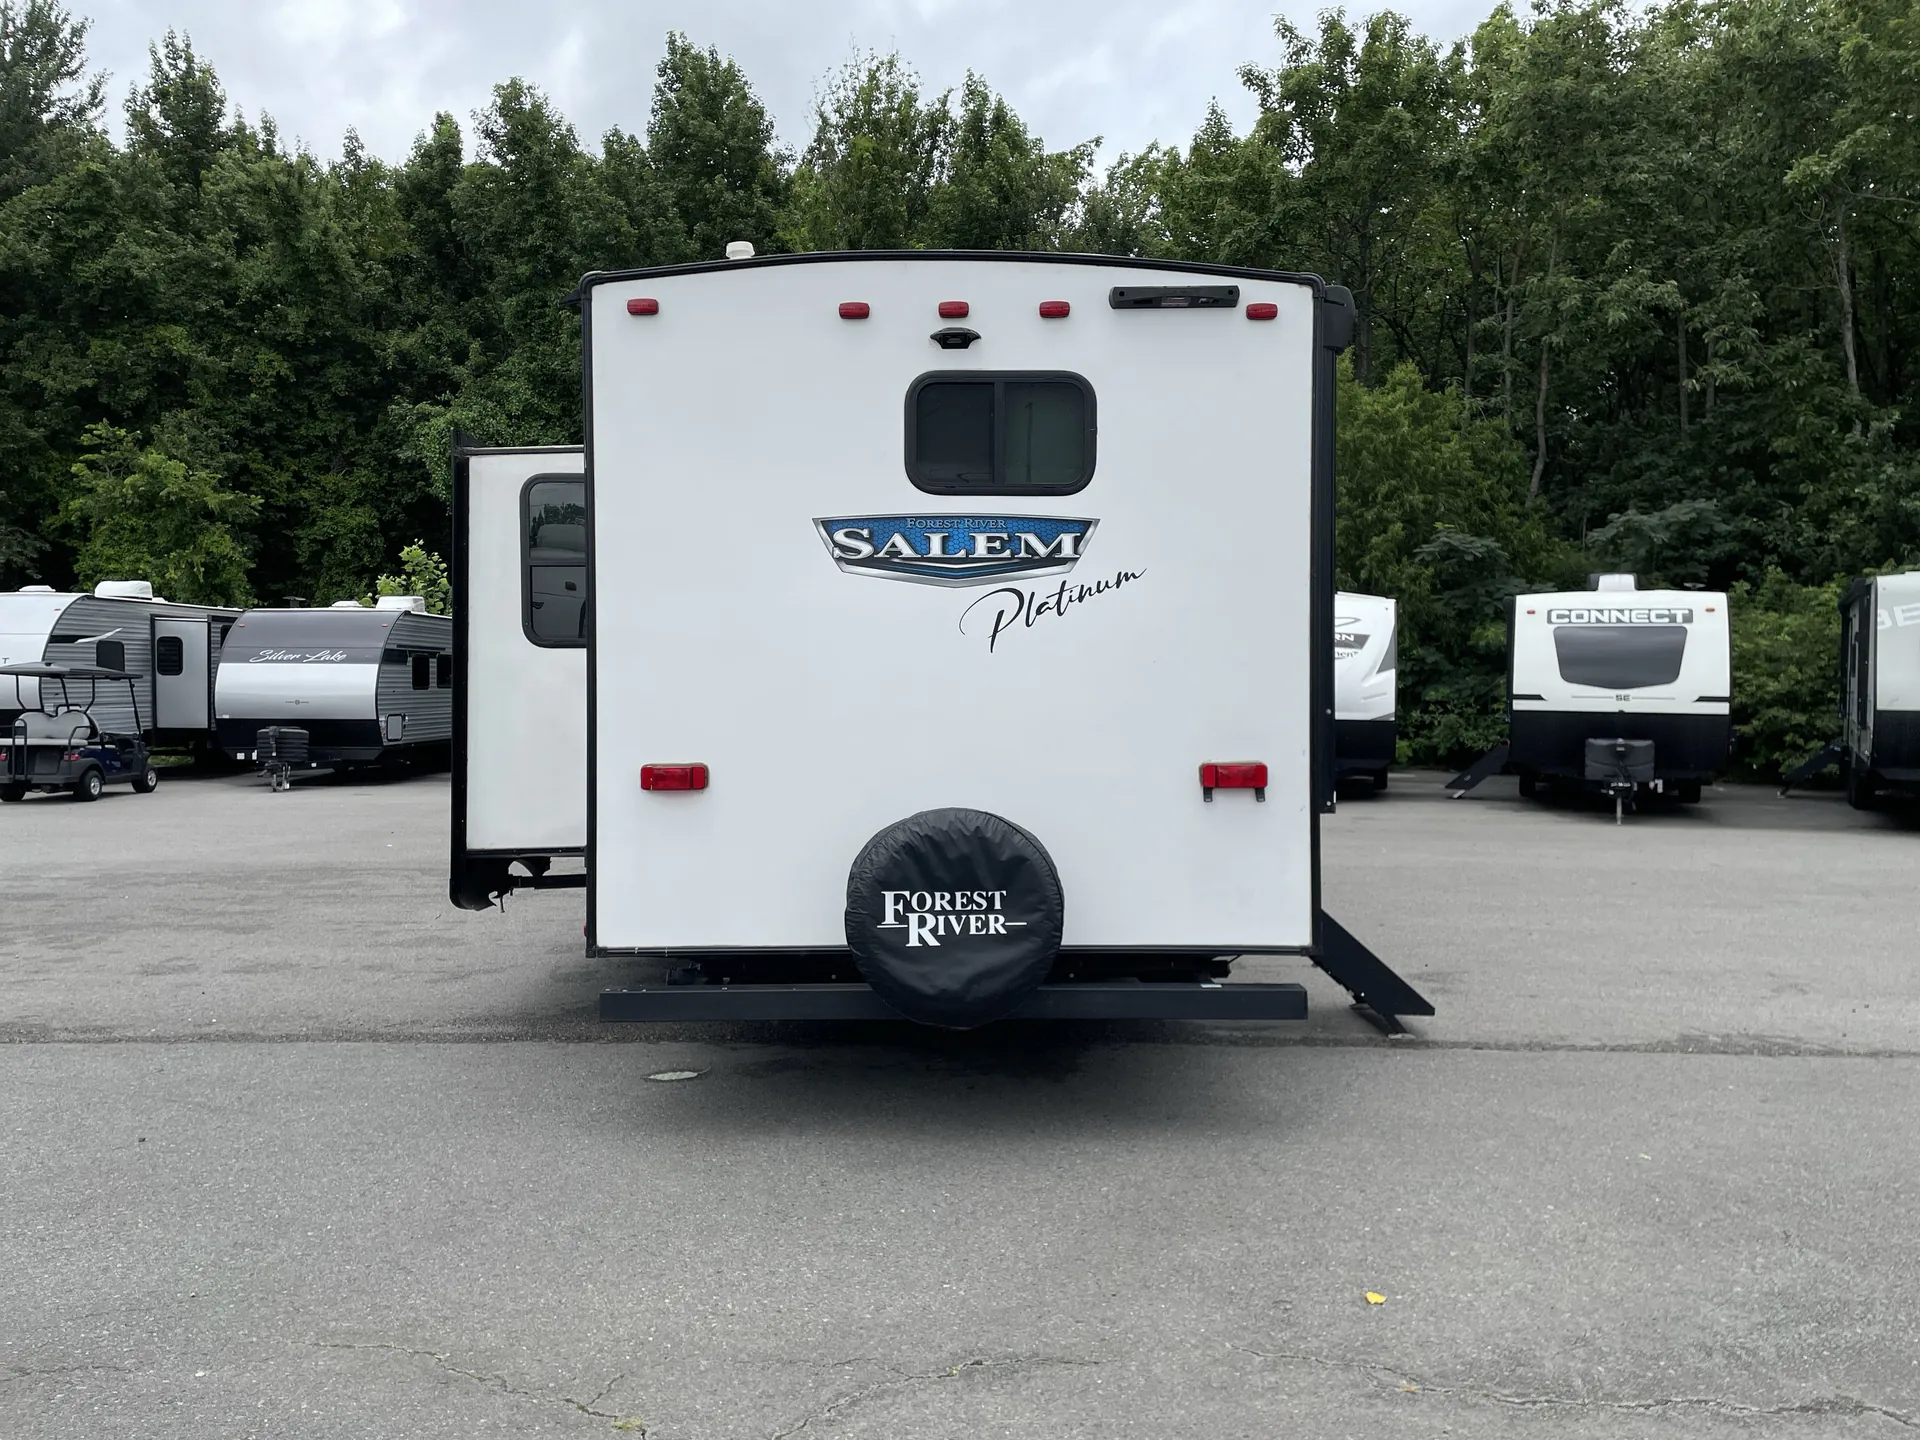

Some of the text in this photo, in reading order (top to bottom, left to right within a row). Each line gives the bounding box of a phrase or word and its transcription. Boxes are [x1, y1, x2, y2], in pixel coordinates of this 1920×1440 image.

[832, 527, 1082, 559] SALEM
[958, 567, 1148, 654] Platinum
[1550, 608, 1690, 624] CONNECT
[249, 649, 348, 663] Silver Lake
[880, 889, 1007, 926] FOREST
[904, 912, 1008, 948] RIVER
